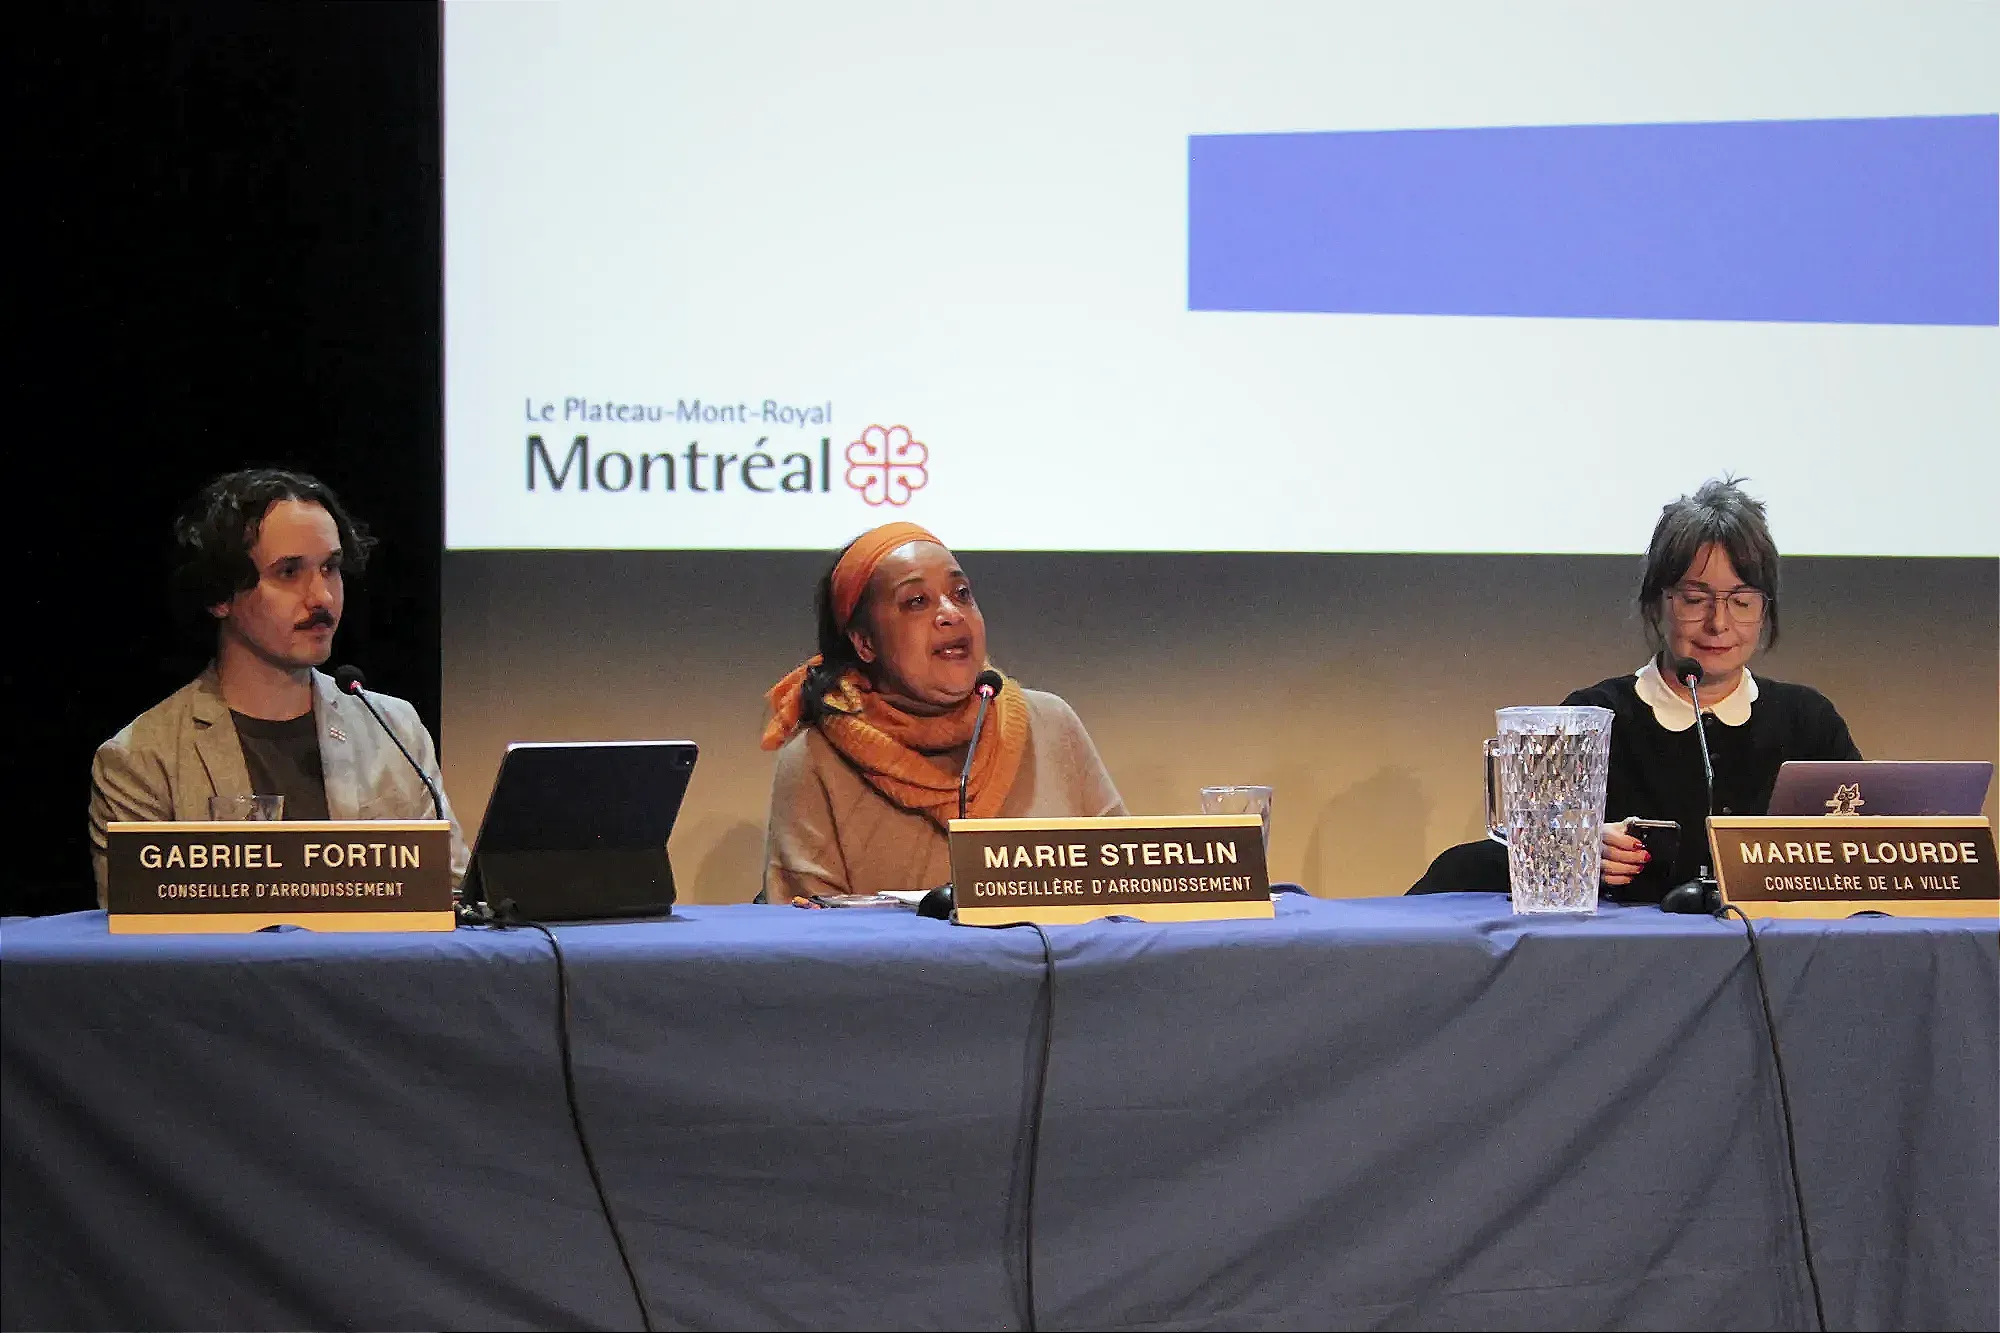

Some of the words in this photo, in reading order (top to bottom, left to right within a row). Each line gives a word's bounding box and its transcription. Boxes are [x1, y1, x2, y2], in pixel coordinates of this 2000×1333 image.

[525, 398, 555, 423] Le
[564, 397, 832, 428] Plateau-Mont-Royal
[526, 434, 831, 493] Montréal
[139, 844, 283, 869] GABRIEL
[303, 843, 421, 868] FORTIN
[983, 844, 1089, 869] MARIE
[1100, 842, 1238, 867] STERLIN
[1740, 842, 1834, 865] MARIE
[1841, 842, 1979, 865] PLOURDE
[157, 883, 250, 898] CONSEILLER
[255, 881, 405, 898] D'ARRONDISSEMENT
[974, 877, 1085, 897] CONSEILLÈRE
[1092, 876, 1252, 895] D'ARRONDISSEMENT
[1765, 874, 1863, 891] CONSEILLÈRE
[1869, 876, 1888, 891] DE
[1894, 875, 1914, 890] LA
[1920, 875, 1961, 890] VILLE
